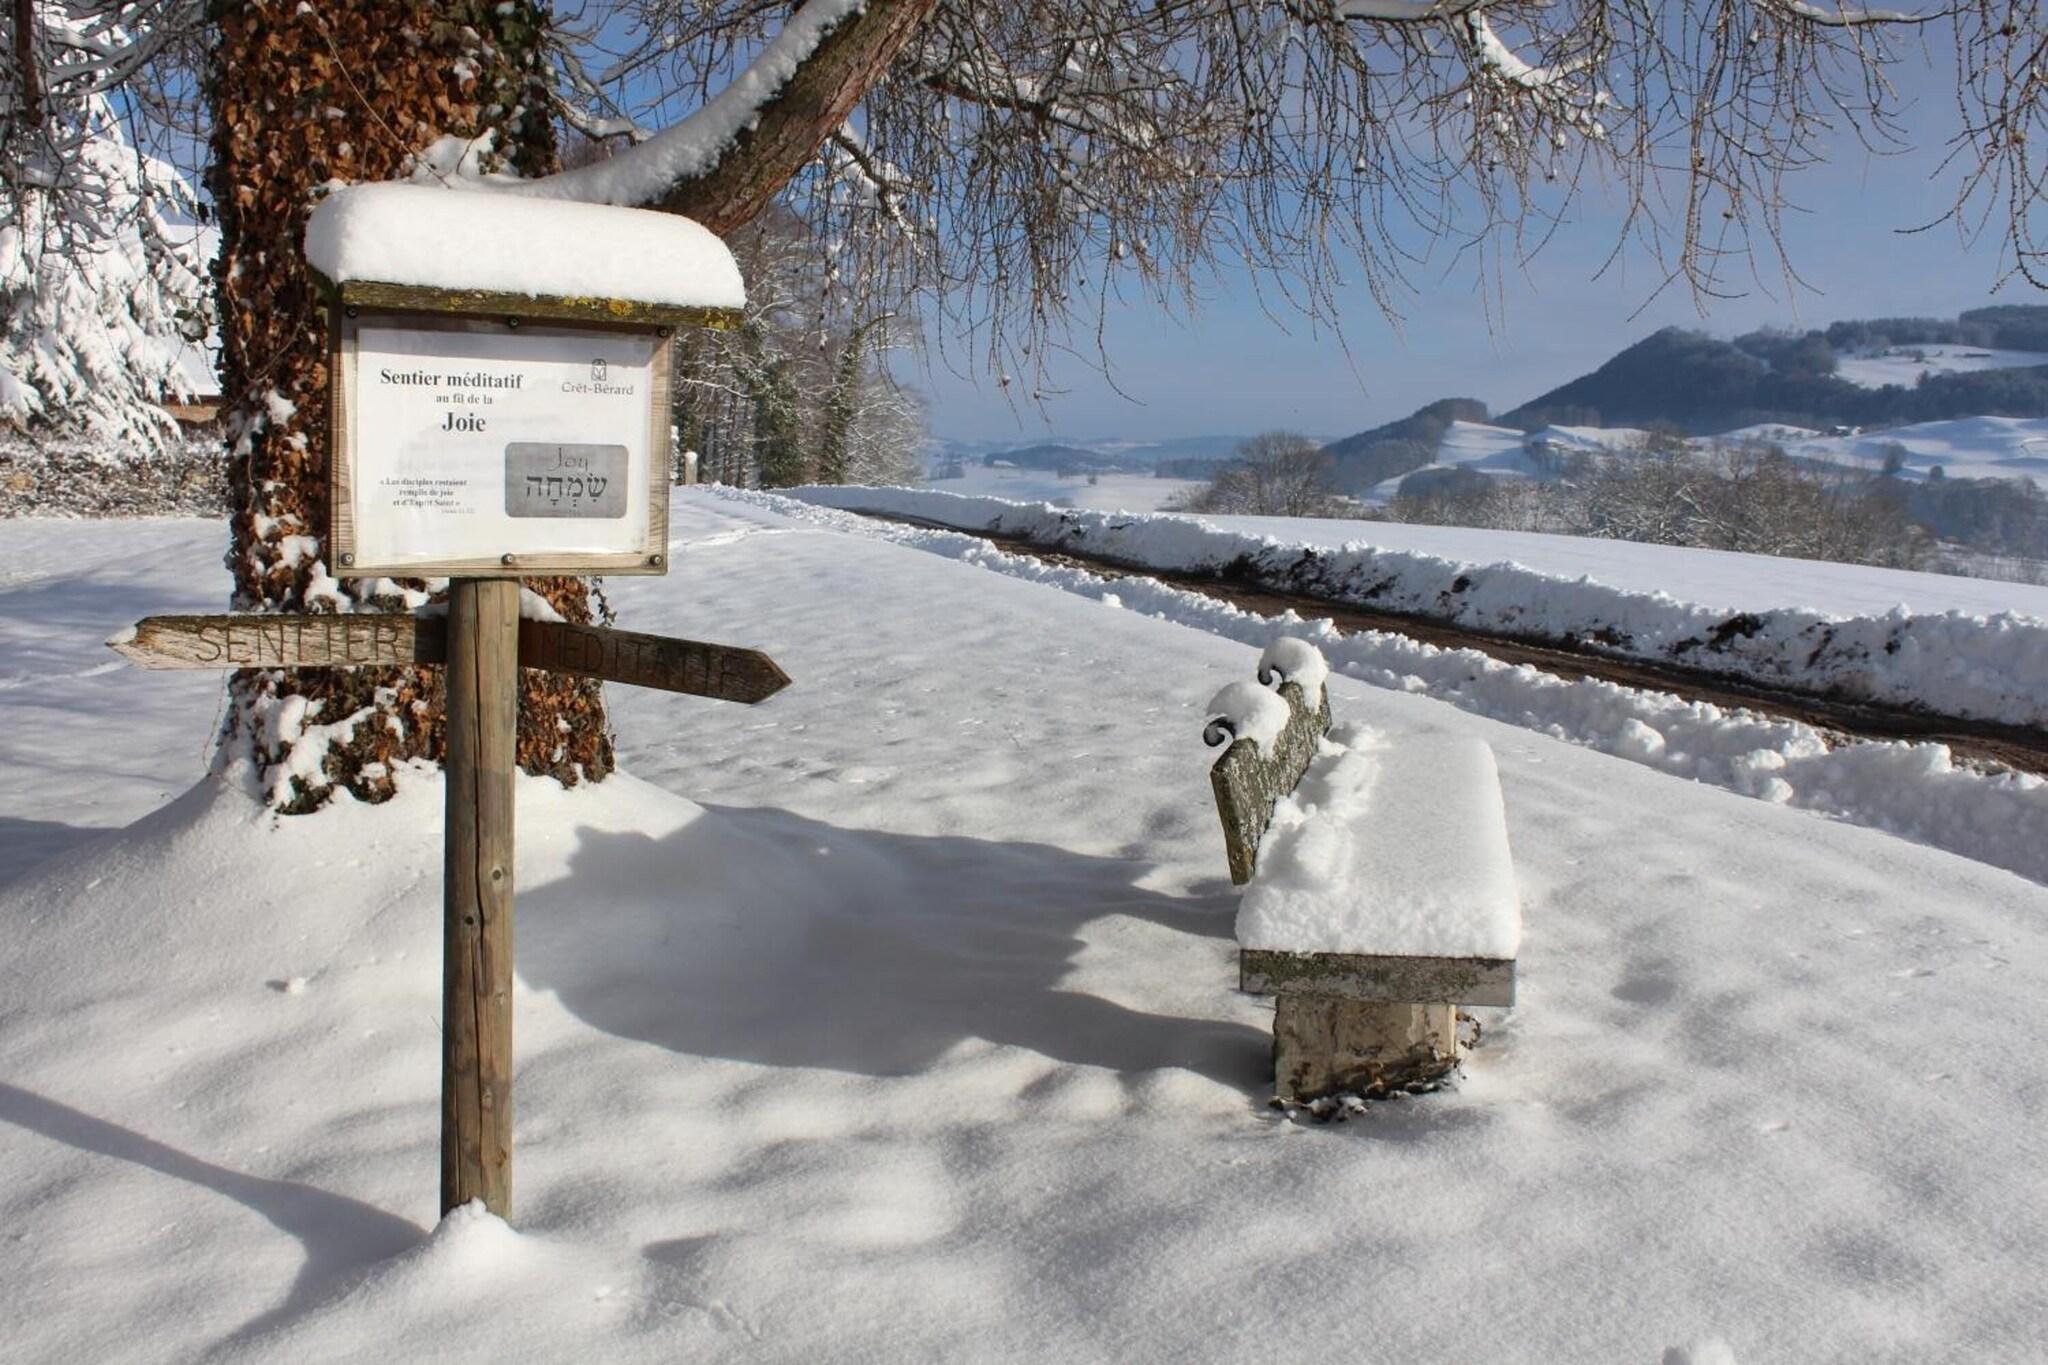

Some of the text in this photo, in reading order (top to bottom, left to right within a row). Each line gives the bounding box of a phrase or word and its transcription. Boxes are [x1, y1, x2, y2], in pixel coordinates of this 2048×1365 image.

[380, 368, 523, 390] Sentier méditatif
[561, 381, 634, 396] Crêt-Bérard
[436, 393, 493, 405] au fil de la
[441, 411, 486, 433] Joie
[547, 447, 588, 472] Joy
[195, 623, 400, 664] SENTIER
[540, 628, 747, 694] MEDITATIF
